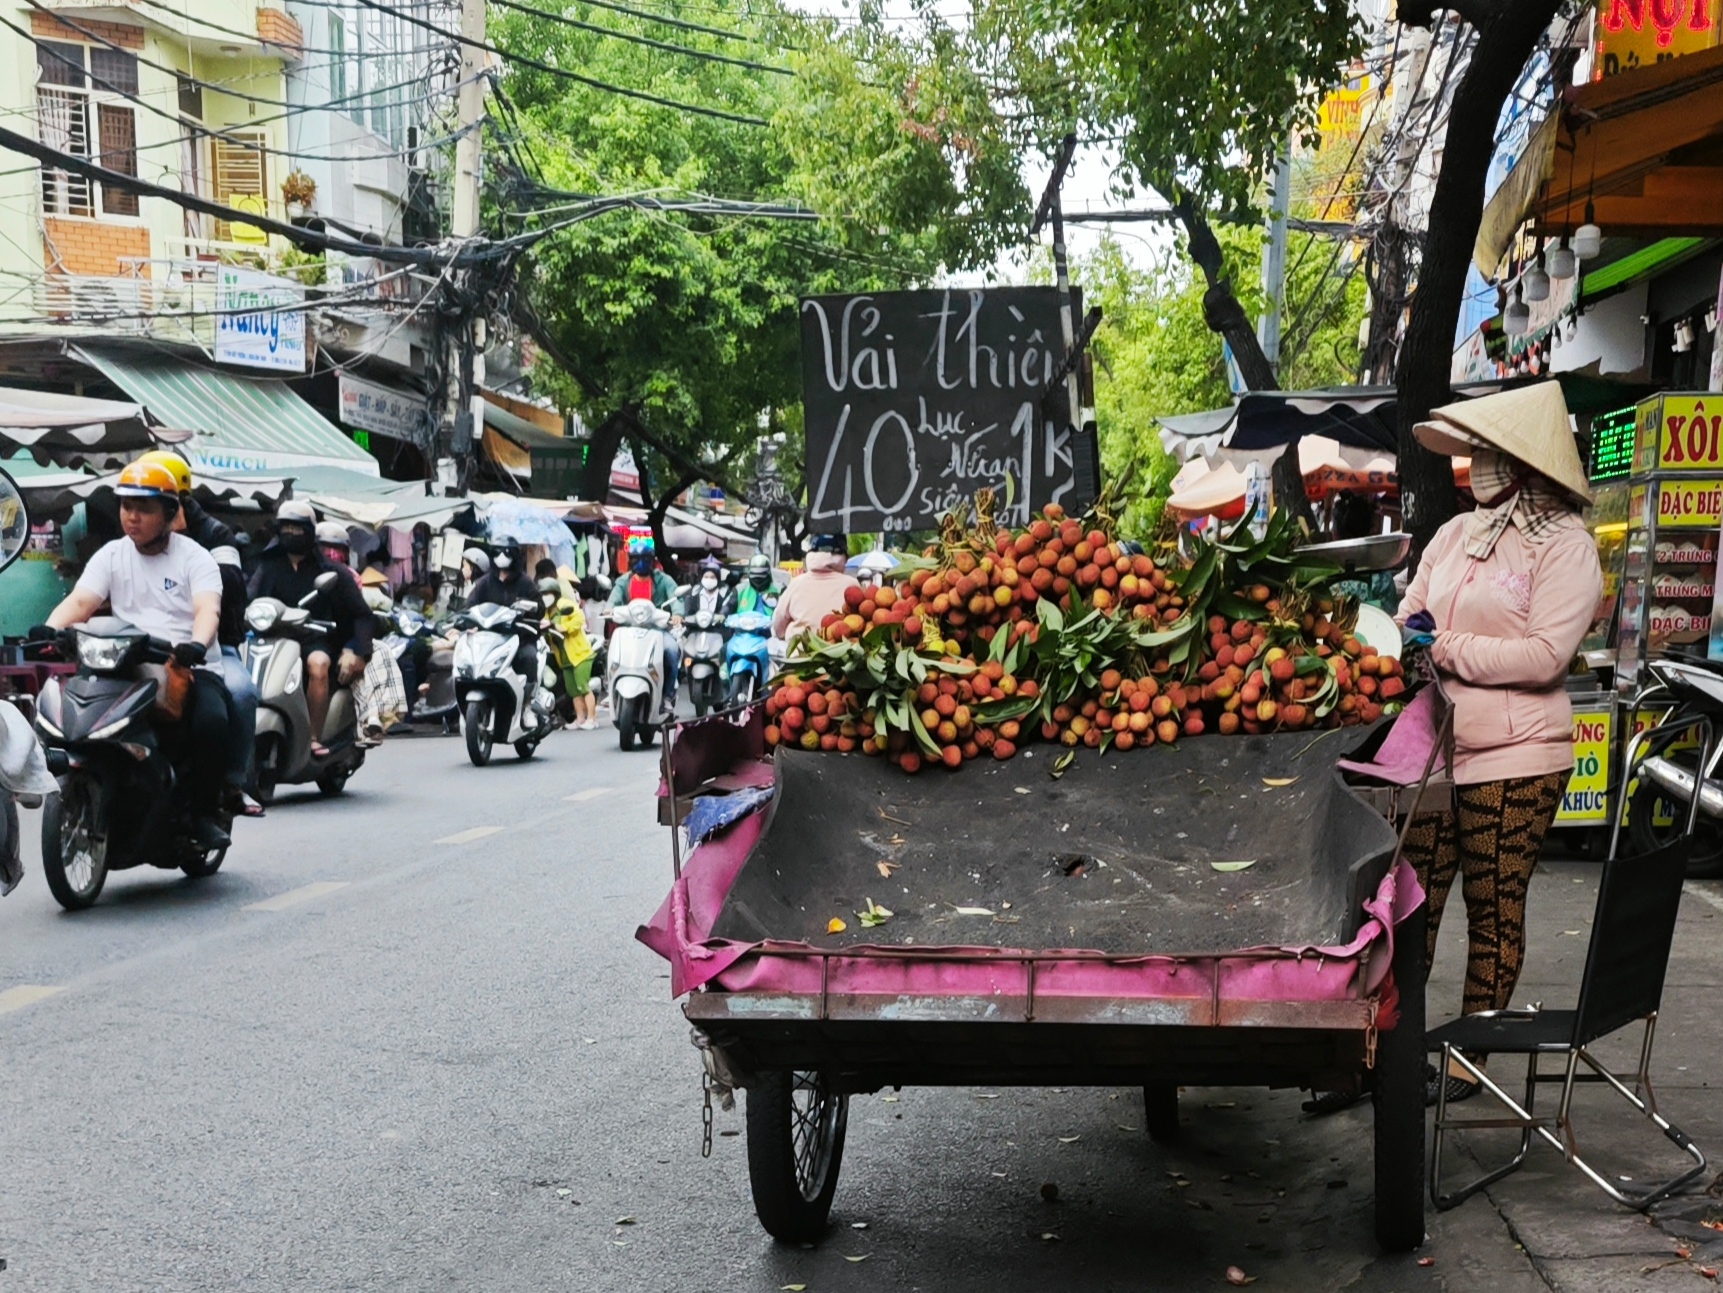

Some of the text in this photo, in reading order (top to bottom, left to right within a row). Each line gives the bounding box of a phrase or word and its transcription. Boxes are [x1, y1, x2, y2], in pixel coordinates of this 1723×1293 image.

[802, 296, 897, 392] Vải
[1663, 400, 1722, 463] XÔI
[811, 403, 919, 533] 40
[1661, 484, 1694, 520] ĐẶC
[1696, 483, 1723, 520] BIỆ
[1659, 551, 1668, 563] 2
[1672, 548, 1712, 563] TRỨNG
[1656, 583, 1699, 598] TRỨNG
[1562, 785, 1605, 811] KHÚC
